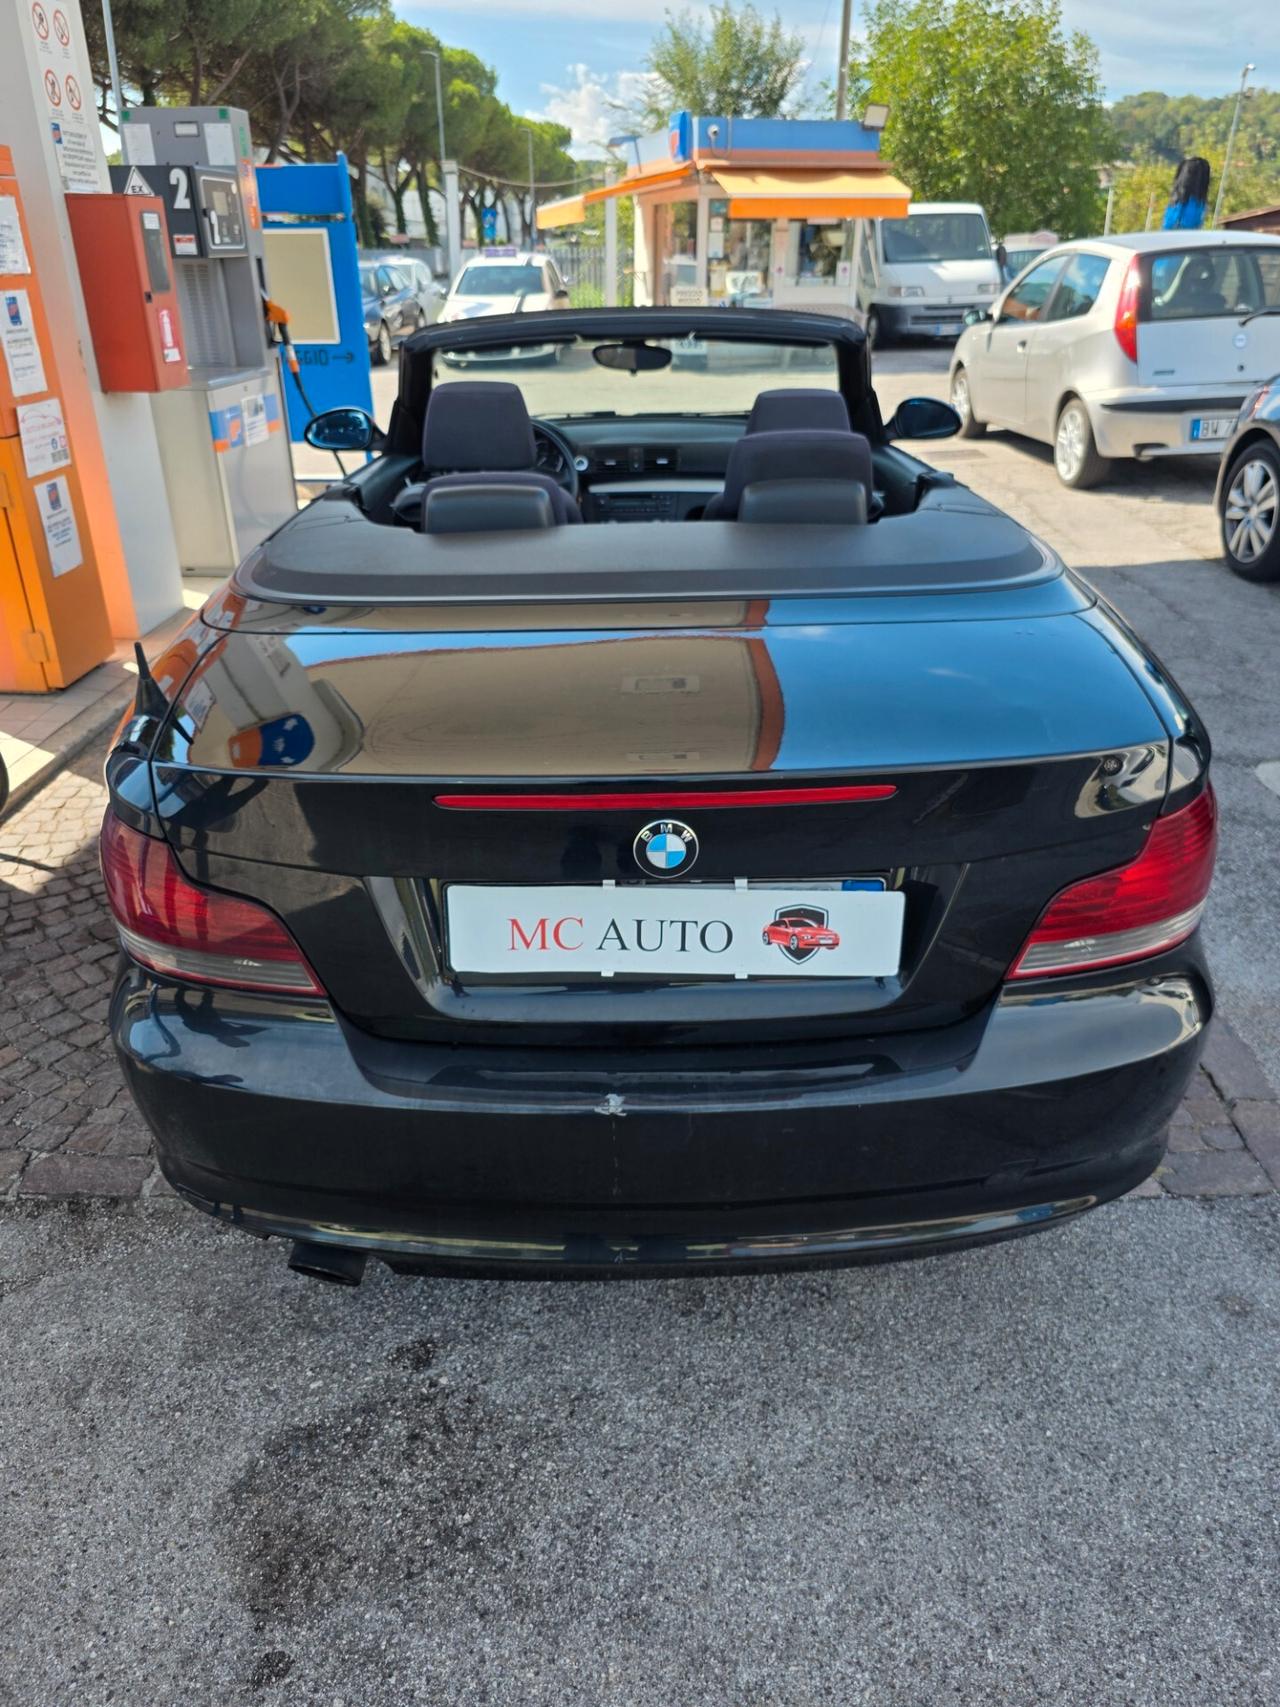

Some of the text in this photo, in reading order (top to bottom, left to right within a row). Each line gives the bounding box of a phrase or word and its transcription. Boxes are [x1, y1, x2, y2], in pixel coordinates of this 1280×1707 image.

[131, 186, 144, 194] EX
[169, 168, 190, 209] 2
[297, 349, 329, 366] GGIO
[641, 823, 693, 843] BMW
[507, 916, 734, 954] MC AUTO
